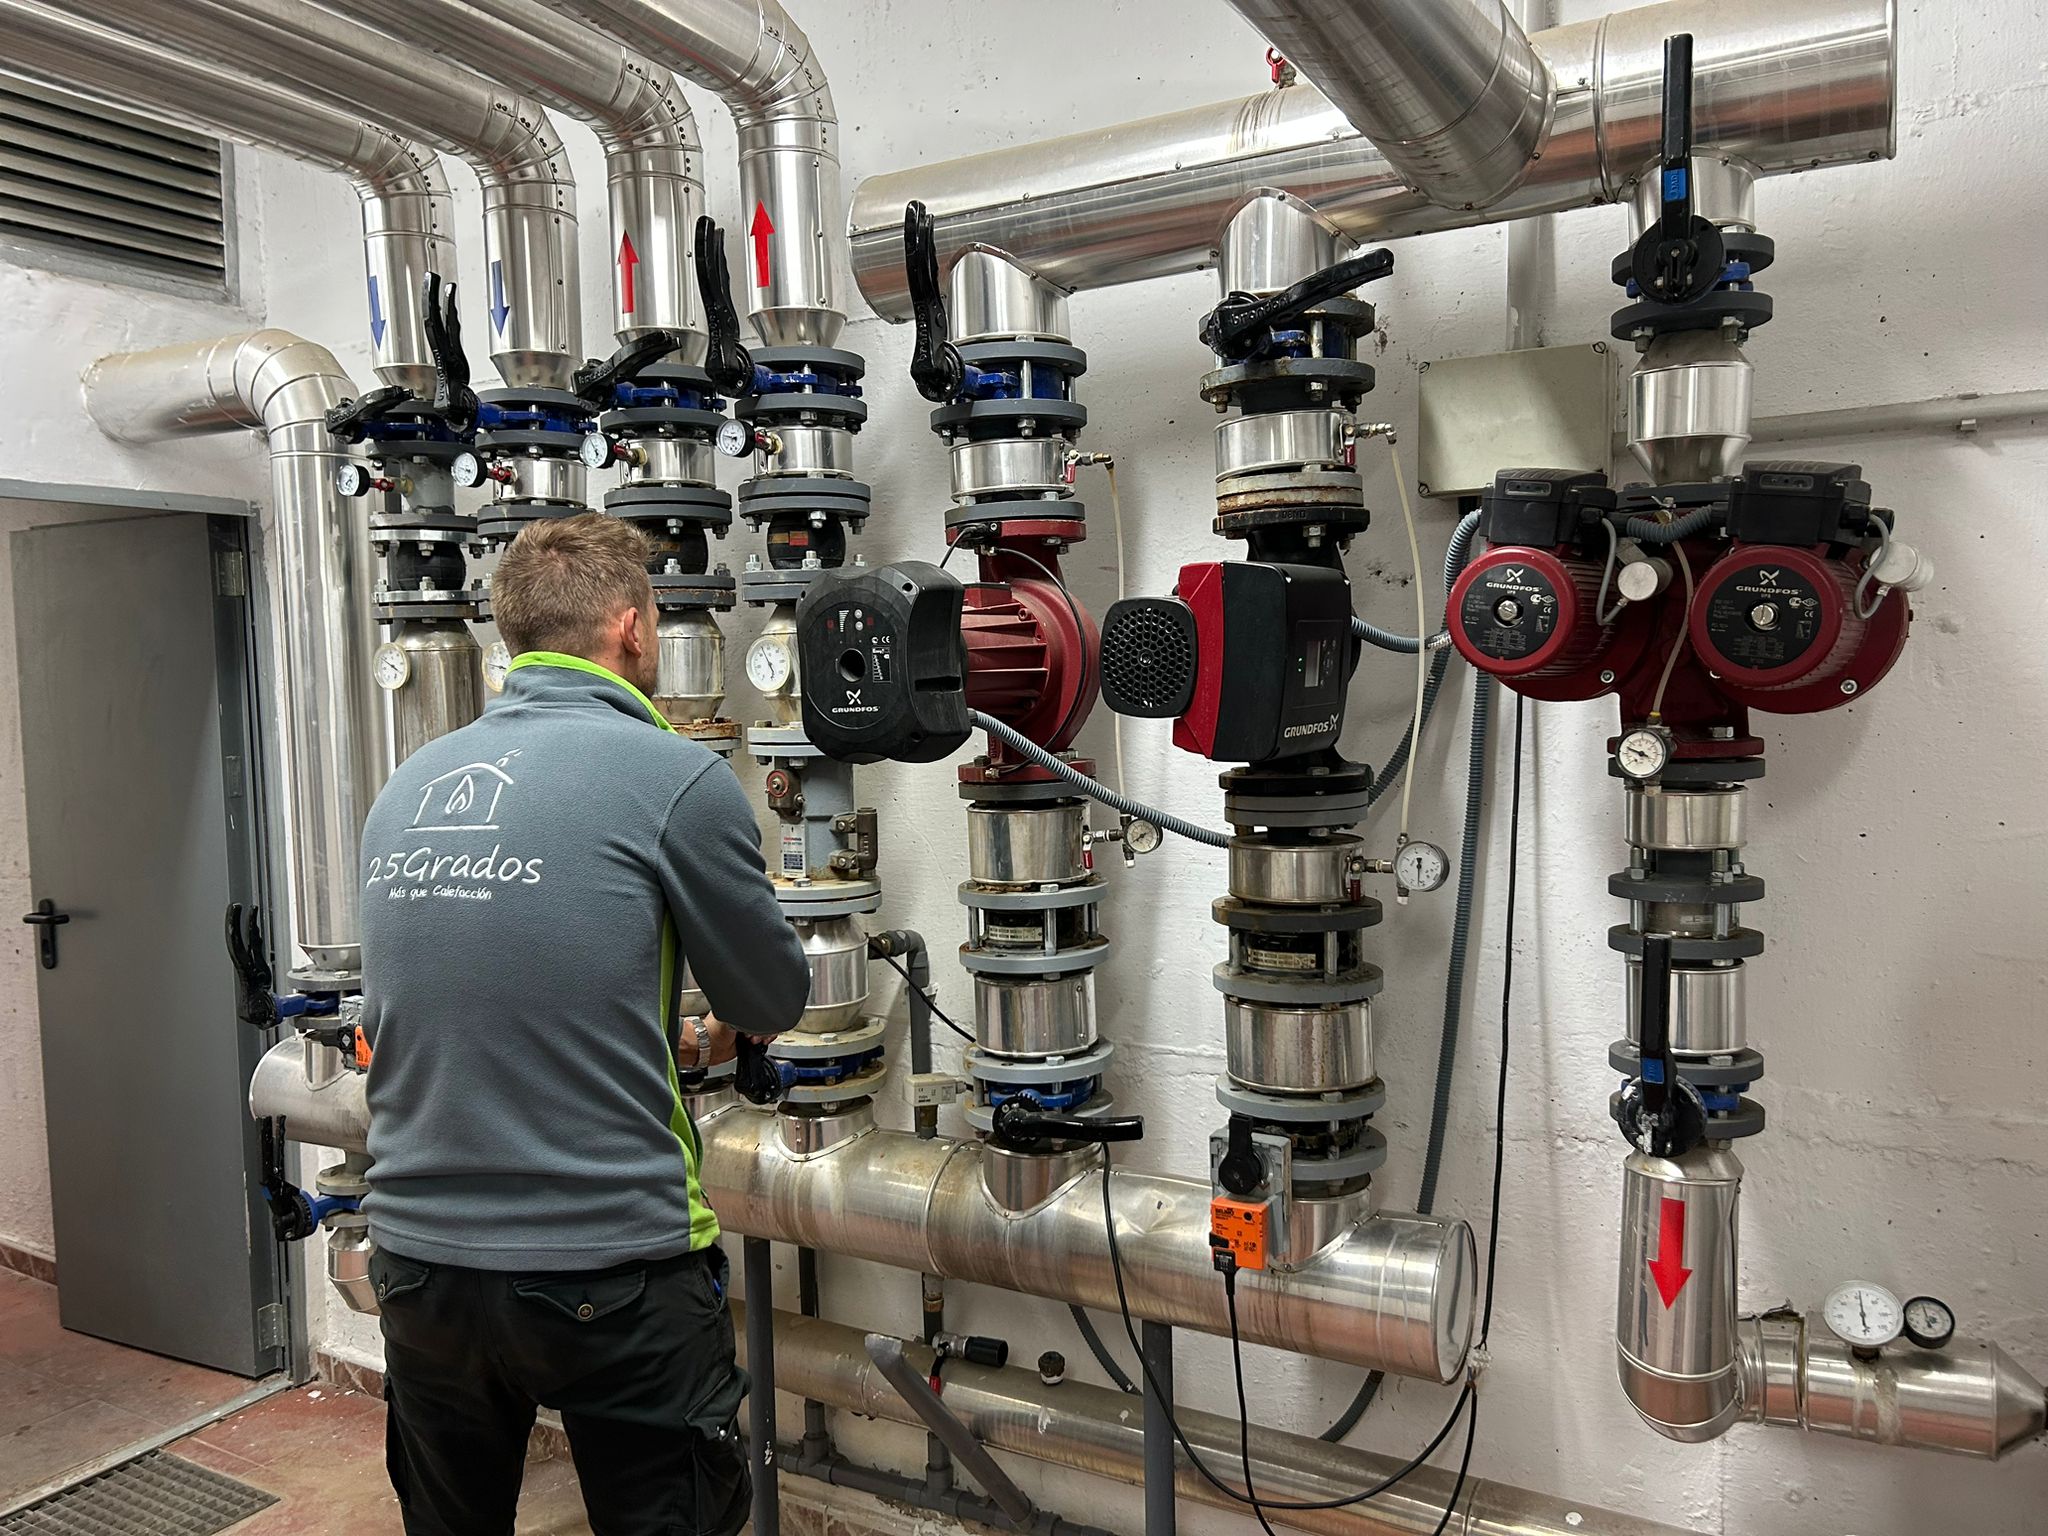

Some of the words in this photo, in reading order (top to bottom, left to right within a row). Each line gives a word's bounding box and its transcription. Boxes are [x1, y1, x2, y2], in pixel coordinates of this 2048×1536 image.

[1486, 582, 1541, 592] GRUNDFOS
[1736, 585, 1799, 595] GRUNDFOS
[1284, 721, 1329, 738] GRUNDFOS
[366, 844, 544, 888] 25Grados
[388, 886, 406, 900] Más
[410, 887, 428, 901] que
[432, 884, 492, 900] Calefacción
